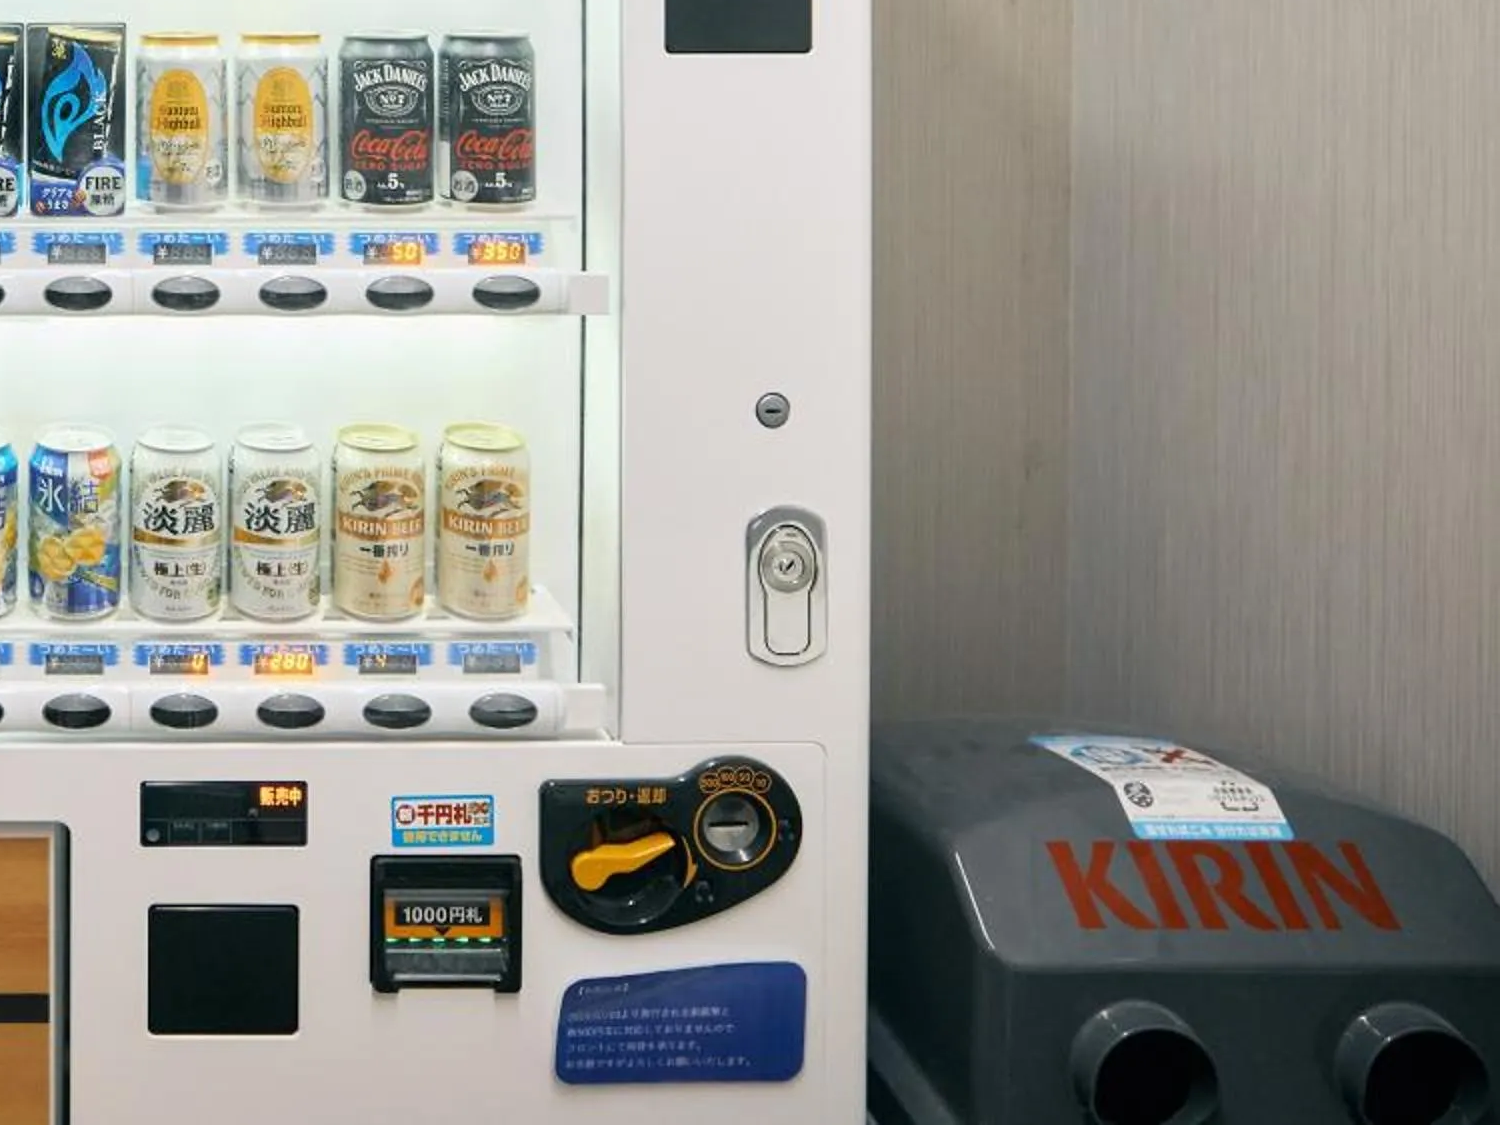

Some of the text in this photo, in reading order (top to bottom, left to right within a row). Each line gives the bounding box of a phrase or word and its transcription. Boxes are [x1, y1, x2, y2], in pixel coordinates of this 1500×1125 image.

[354, 68, 382, 92] JACK
[459, 67, 490, 92] JACK
[84, 177, 122, 191] FIRE
[144, 502, 215, 535] 淡麗
[244, 502, 316, 535] 淡麗
[343, 517, 388, 536] KIRIN
[450, 516, 493, 535] KIRIN
[260, 787, 302, 807] 販売中
[417, 803, 472, 825] 千円札
[1045, 840, 1402, 931] KIRIN
[402, 906, 483, 924] 1000円札
